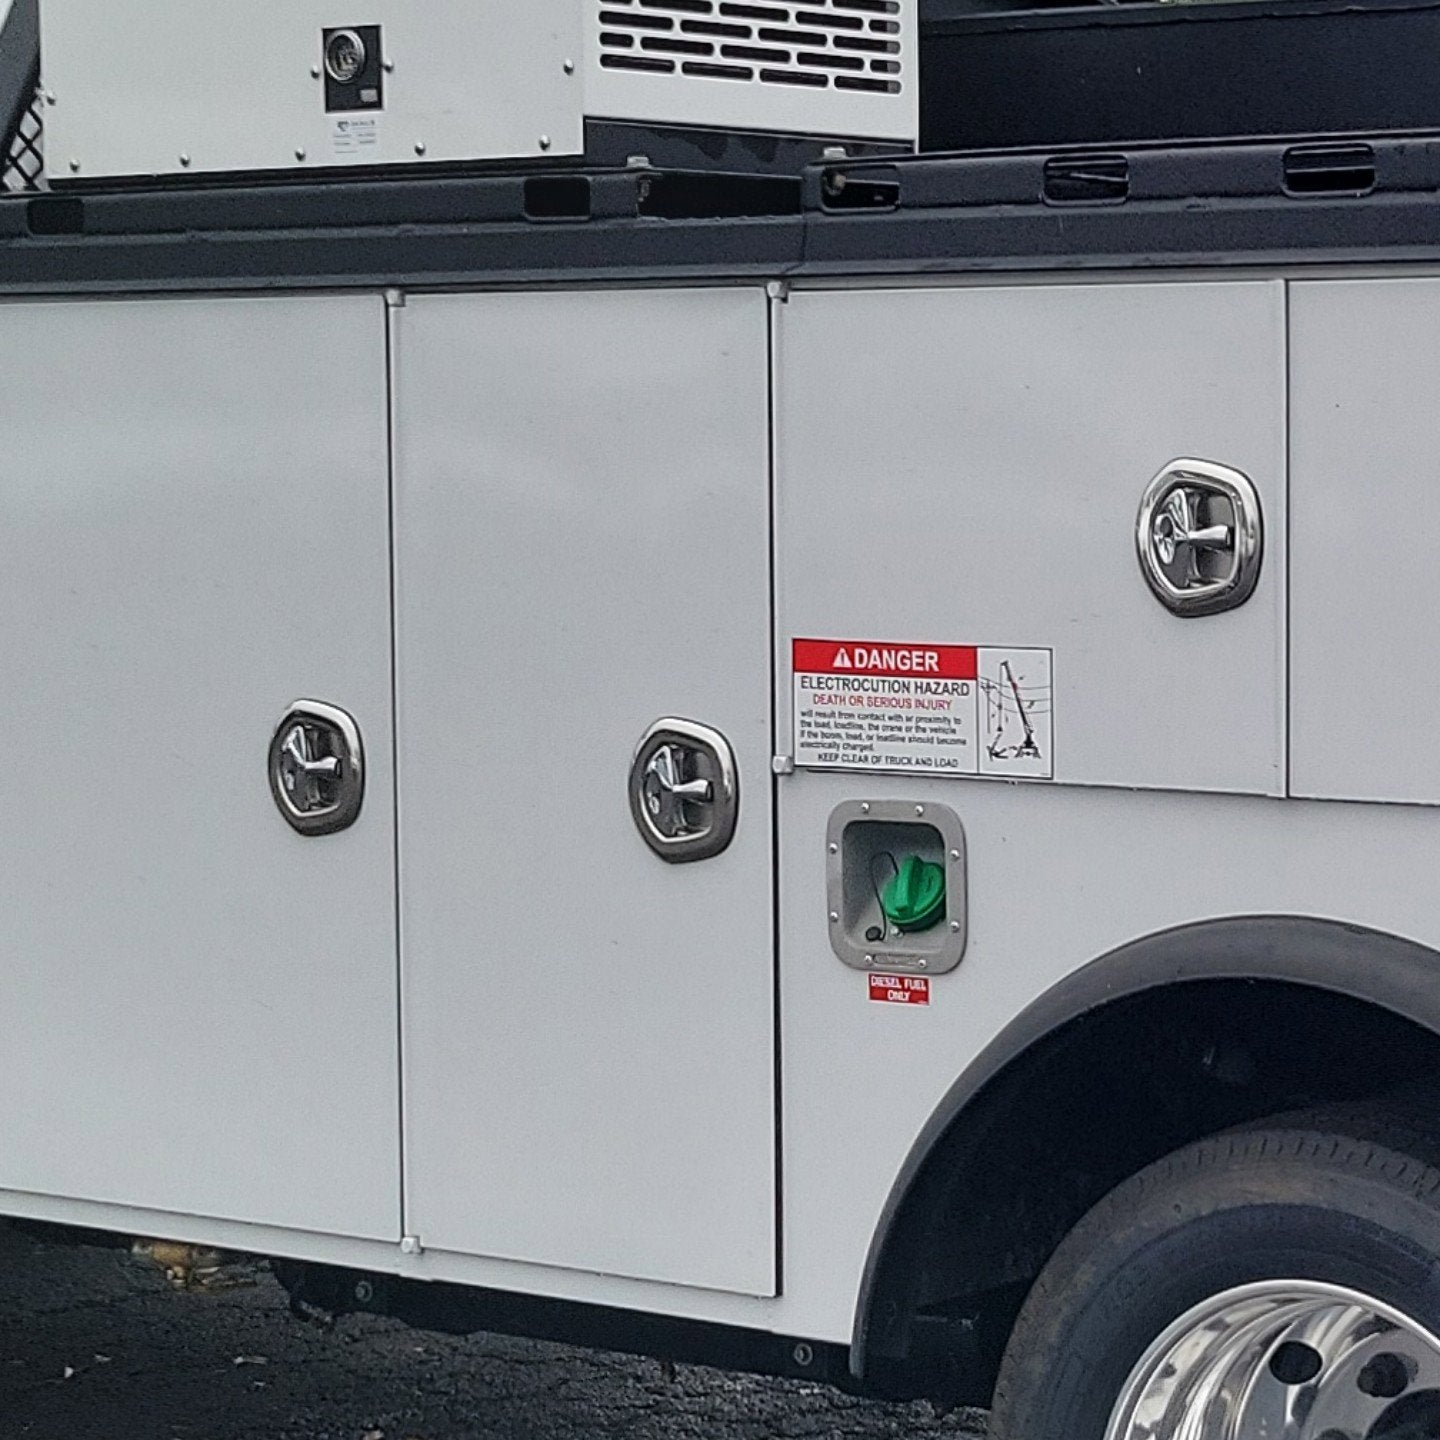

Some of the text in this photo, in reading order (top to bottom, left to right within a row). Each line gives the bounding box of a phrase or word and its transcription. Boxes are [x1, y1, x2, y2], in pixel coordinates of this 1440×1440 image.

[854, 647, 940, 672] DANGER
[800, 675, 970, 696] ELECTROCUTION HAZARD
[813, 693, 953, 711] DEATH OR SERIOUS INJURY
